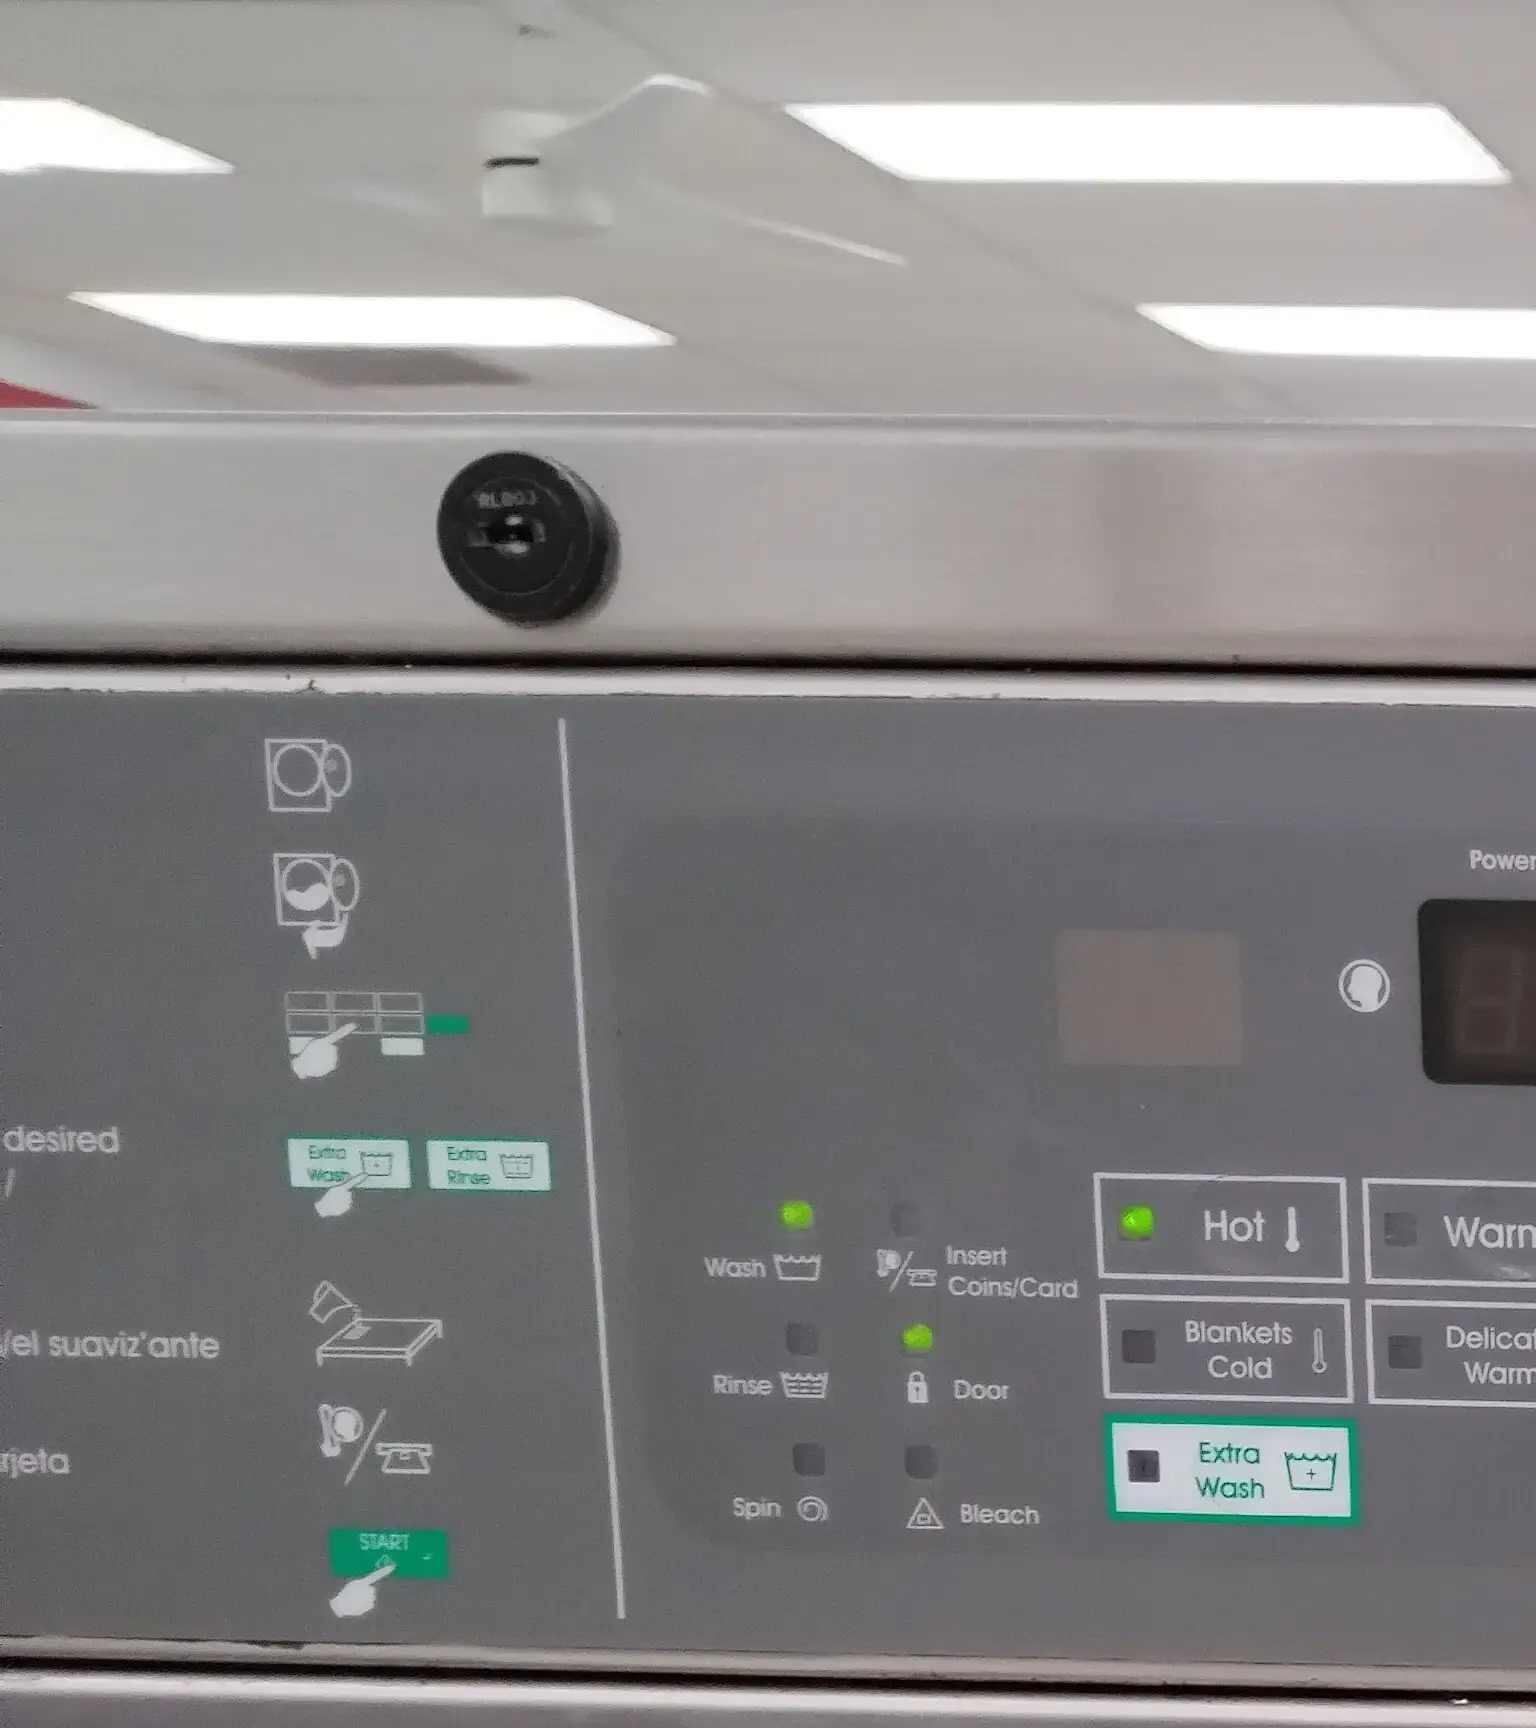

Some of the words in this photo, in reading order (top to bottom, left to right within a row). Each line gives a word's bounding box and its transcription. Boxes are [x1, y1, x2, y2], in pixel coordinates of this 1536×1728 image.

[3, 1125, 120, 1154] desired
[308, 1144, 347, 1160] Extra
[447, 1146, 488, 1161] Extra
[447, 1169, 492, 1185] Rinse
[1203, 1210, 1266, 1242] Hot
[945, 1246, 1008, 1266] Insert
[705, 1257, 767, 1279] Wash
[948, 1277, 1080, 1299] Coins/Card
[1184, 1319, 1293, 1344] Blankets
[1207, 1356, 1273, 1380] Cold
[713, 1375, 774, 1397] Rinse
[953, 1379, 1010, 1400] Door
[1199, 1442, 1261, 1465] Extra
[1196, 1476, 1265, 1501] Wash
[733, 1496, 782, 1521] Spin
[960, 1503, 1040, 1526] Bleach
[359, 1532, 410, 1551] START
